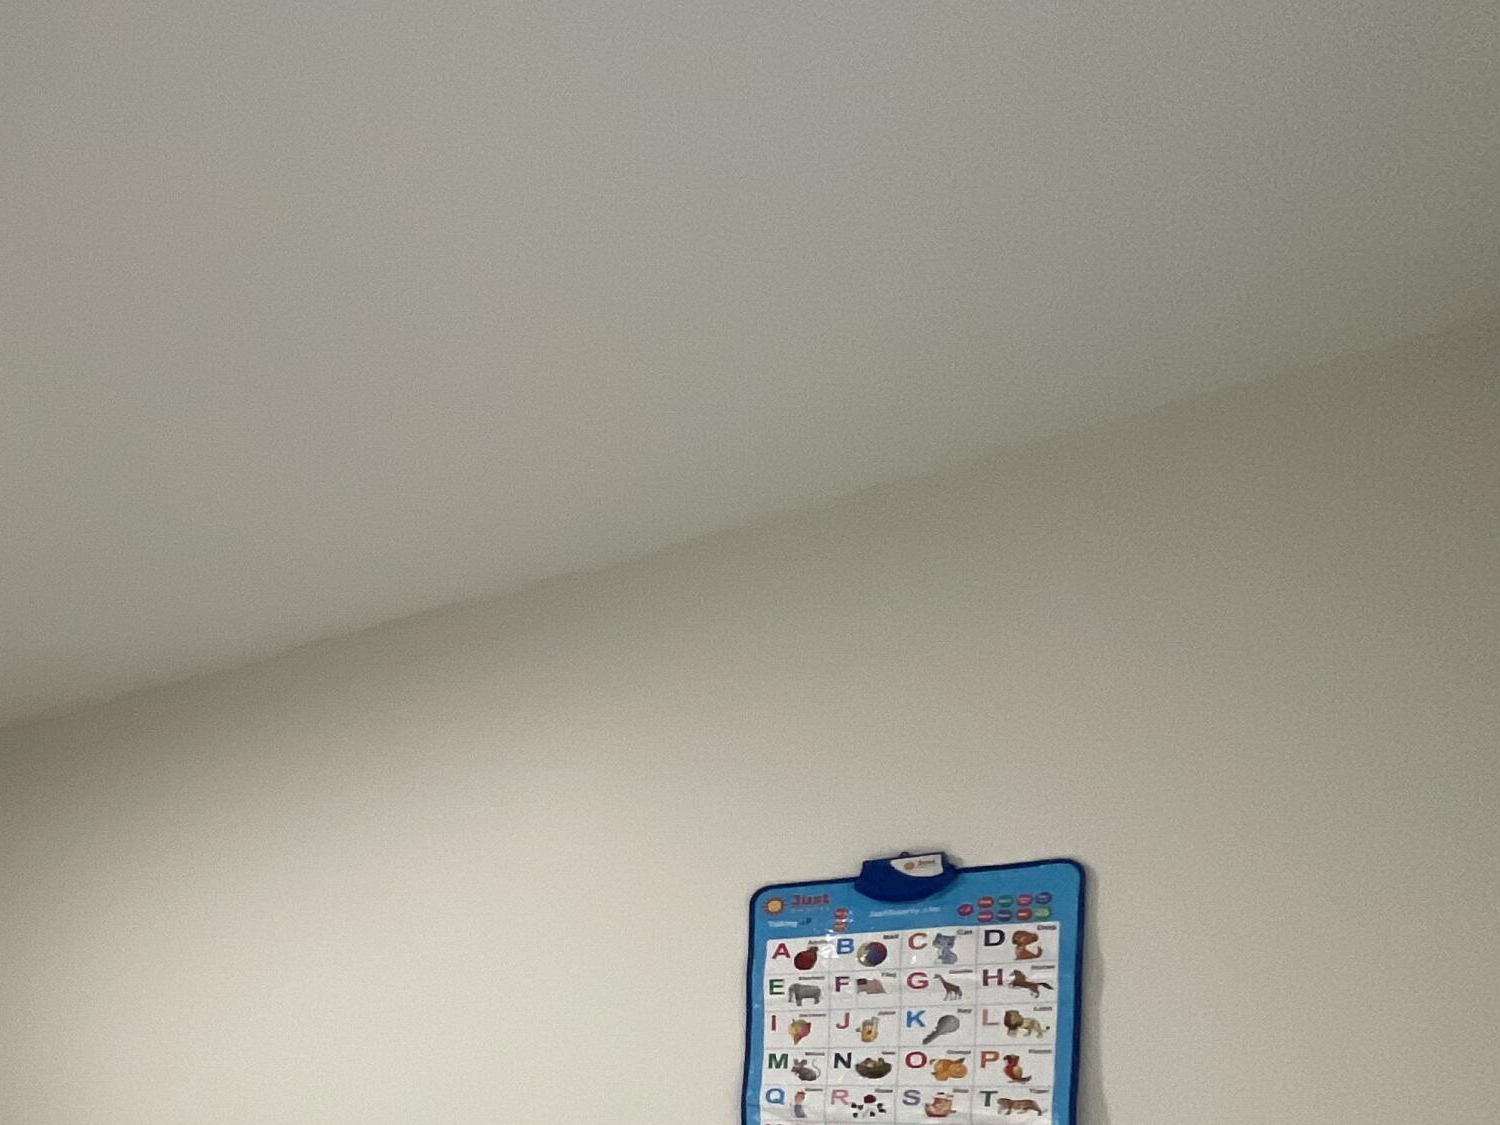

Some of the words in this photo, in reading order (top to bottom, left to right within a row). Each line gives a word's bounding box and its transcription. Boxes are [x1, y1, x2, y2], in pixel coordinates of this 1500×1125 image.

[908, 932, 928, 950] C
[984, 929, 1005, 946] D
[772, 943, 791, 959] A
[836, 938, 854, 955] B
[835, 976, 850, 992] F
[906, 972, 929, 990] G
[982, 968, 1003, 986] H
[769, 979, 785, 995] E
[836, 1012, 850, 1029] J
[906, 1010, 926, 1028] K
[982, 1008, 999, 1026] L
[768, 1053, 788, 1069] M
[834, 1052, 852, 1068] N
[905, 1051, 927, 1068] O
[980, 1051, 999, 1068] P
[765, 1088, 785, 1105] Q
[831, 1089, 849, 1105] R
[902, 1089, 921, 1106] S
[979, 1090, 999, 1107] T
